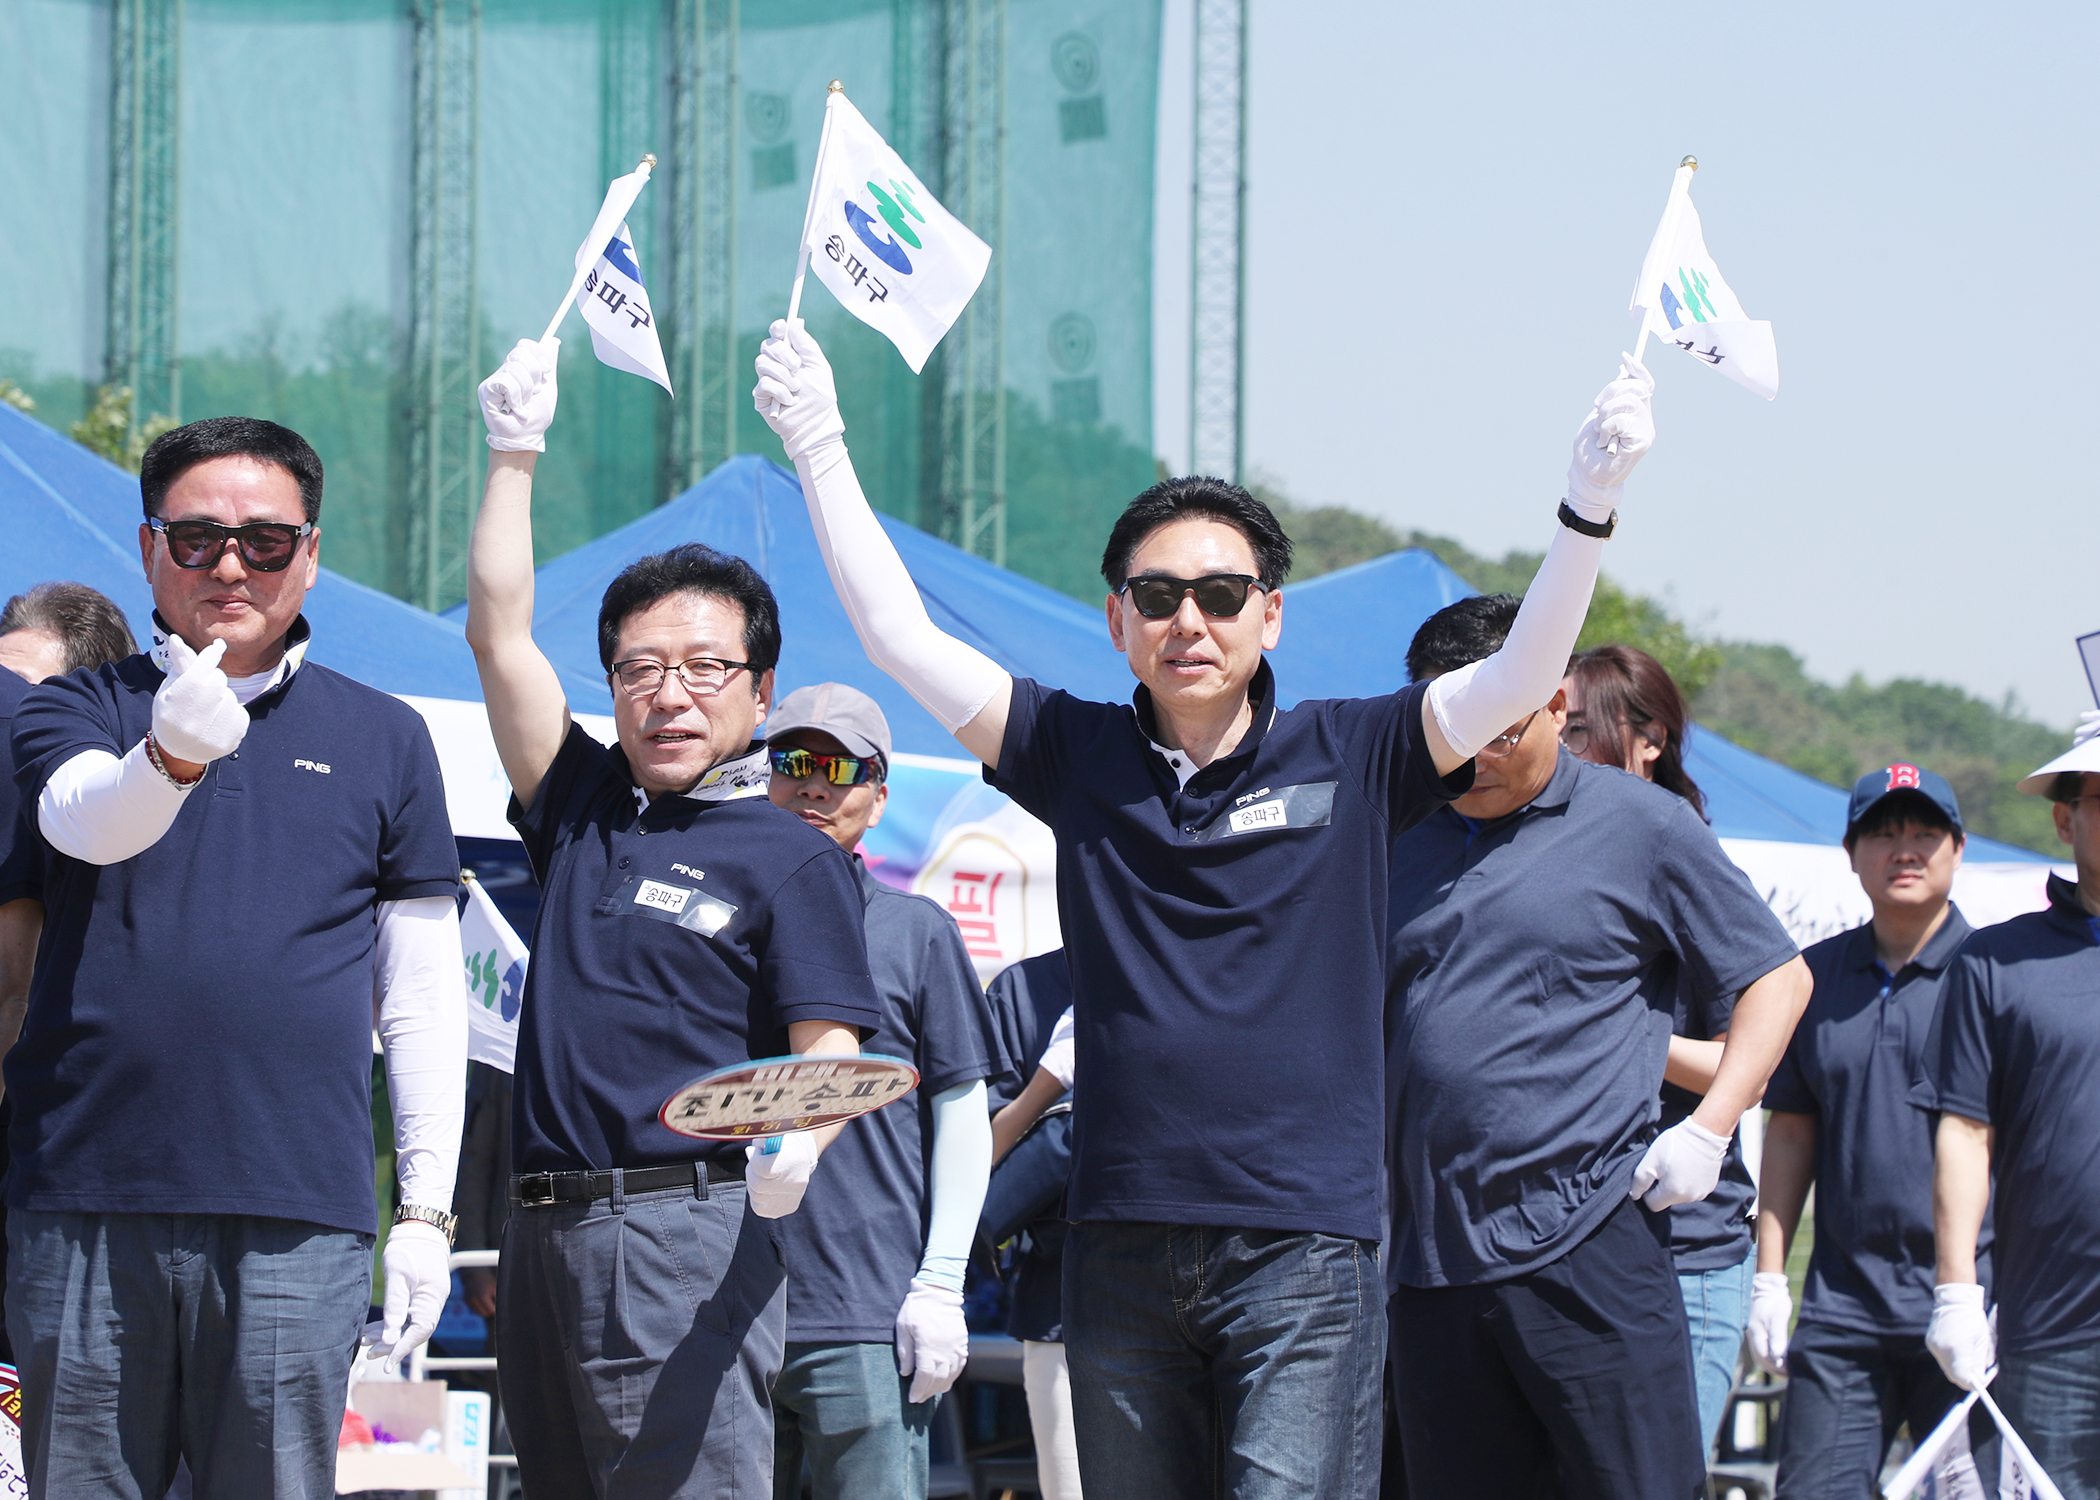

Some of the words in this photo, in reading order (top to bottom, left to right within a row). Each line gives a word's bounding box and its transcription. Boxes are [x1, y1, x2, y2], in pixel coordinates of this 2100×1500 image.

[825, 234, 889, 303] 송파구
[294, 758, 331, 774] PING
[1886, 763, 1920, 792] B
[1236, 786, 1271, 807] PING
[1240, 805, 1280, 826] 송파구
[670, 863, 706, 880] PING
[645, 887, 683, 908] 송파구
